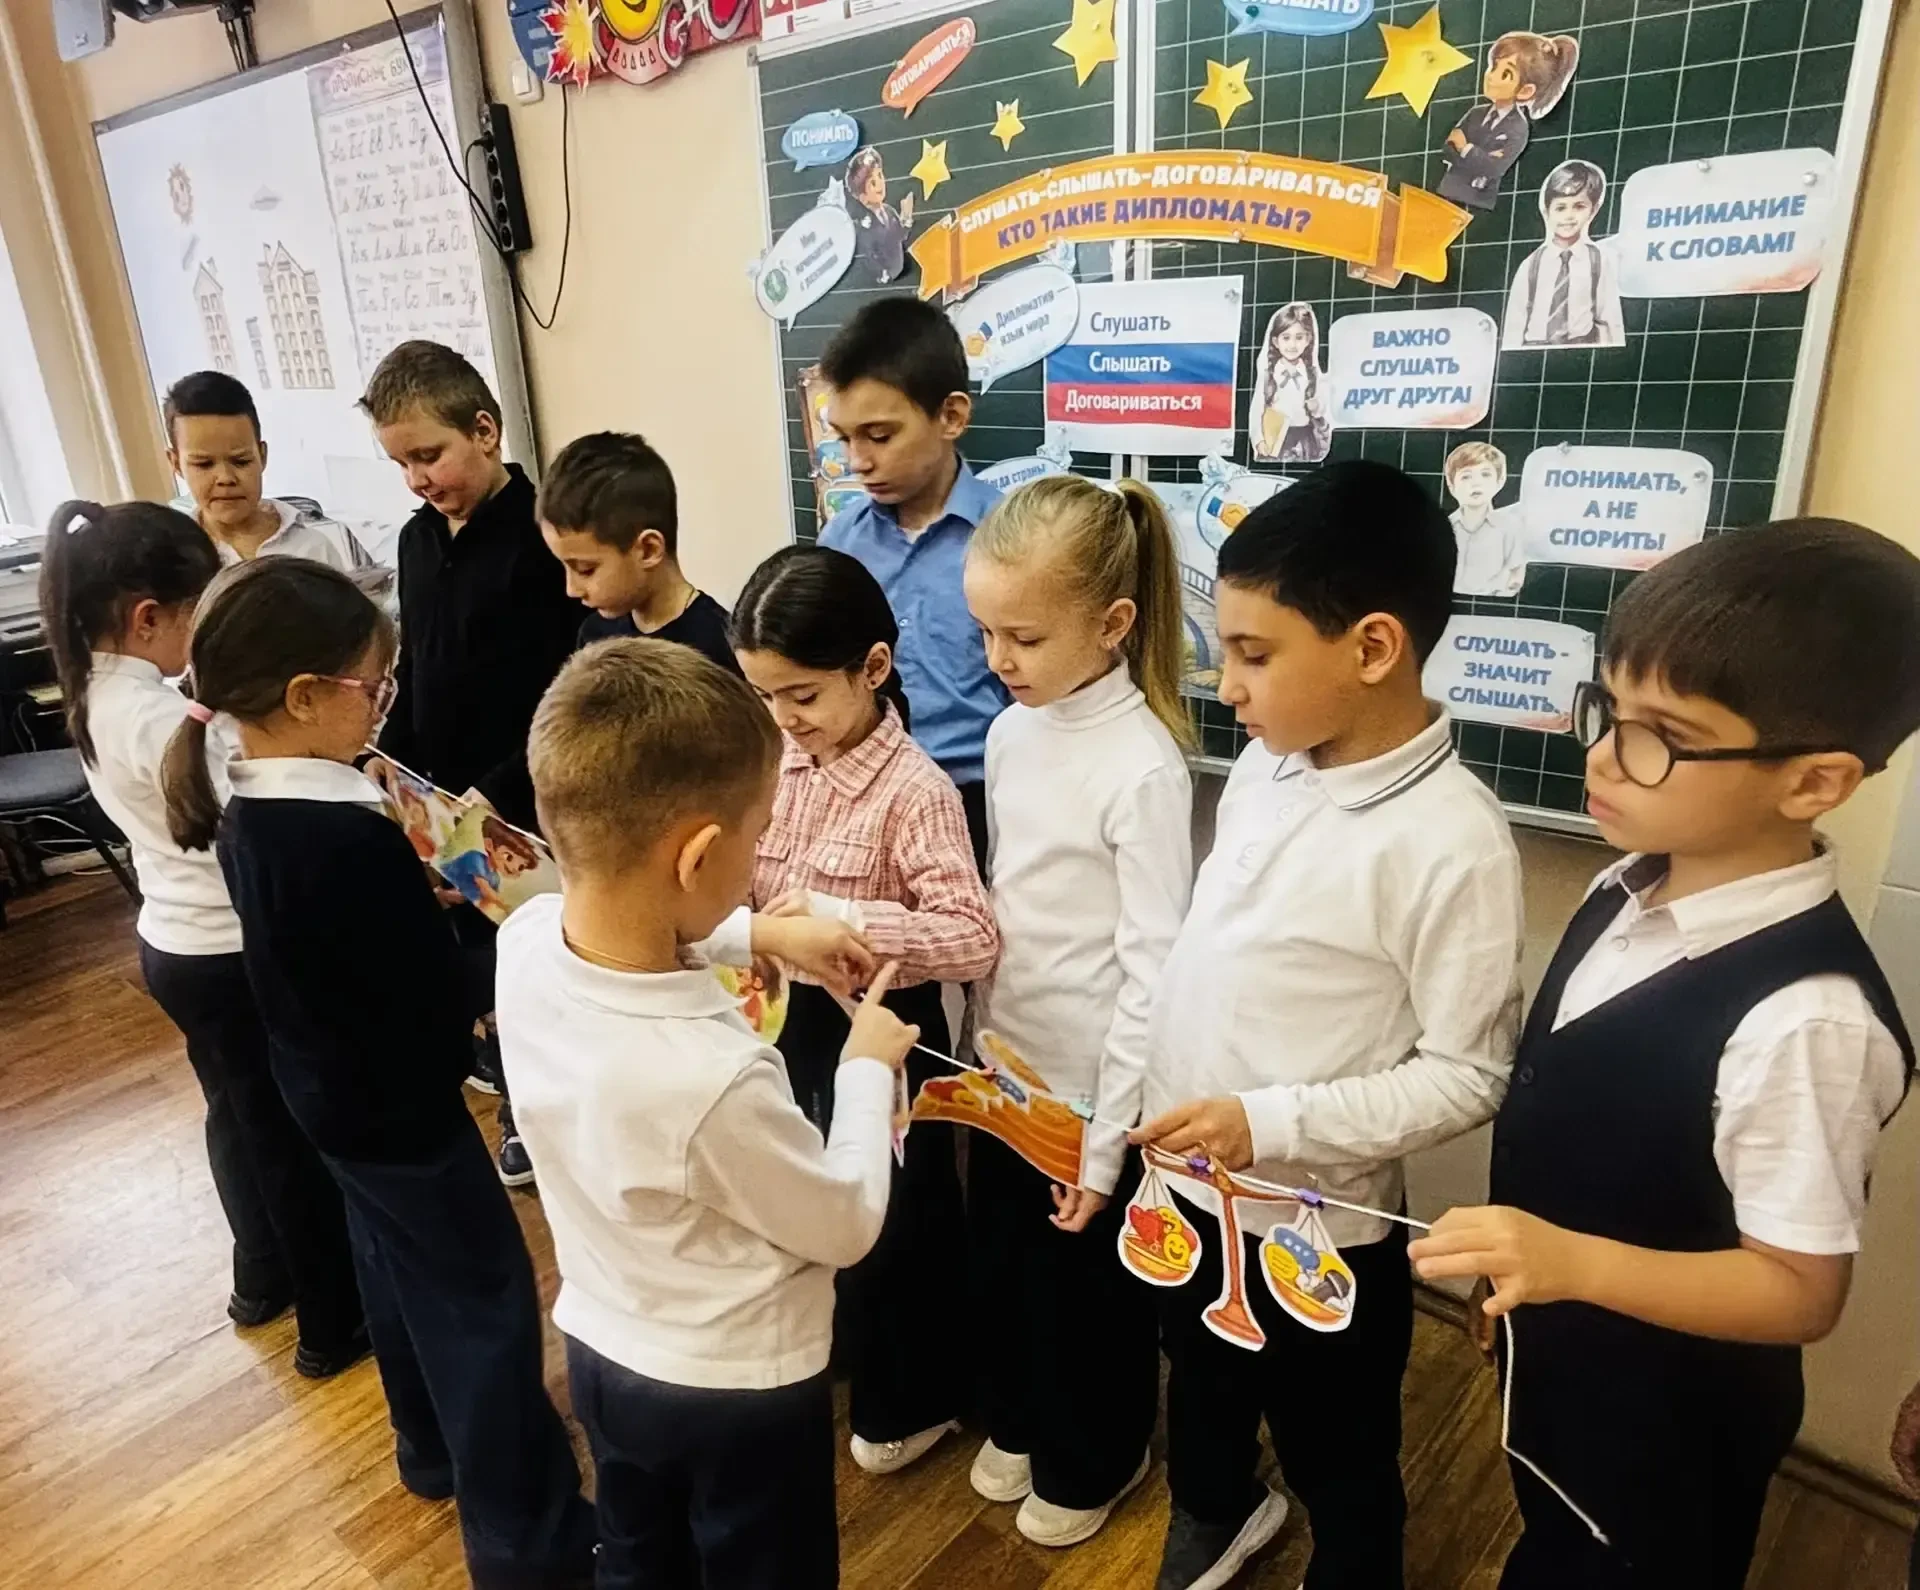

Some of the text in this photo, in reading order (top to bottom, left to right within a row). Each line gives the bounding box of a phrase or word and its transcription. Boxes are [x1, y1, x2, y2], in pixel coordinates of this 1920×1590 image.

[390, 51, 422, 78] БУКЫ
[890, 23, 971, 98] ДОГОВАРИВАТЬСЯ
[791, 124, 854, 148] ПОНИМАТЬ
[997, 197, 1312, 249] КТО ТАКИЕ ДИПЛОМАТЫ?
[1646, 194, 1807, 229] ВНИМАНИЕ
[1646, 231, 1796, 262] К СЛОВАМ!
[996, 289, 1054, 330] Дипломатия
[1025, 313, 1050, 333] мира
[1090, 312, 1171, 338] Слушать
[1372, 327, 1451, 349] ВАЖНО
[1089, 351, 1171, 374] Слышать
[1360, 357, 1460, 377] СЛУШАТЬ
[1065, 389, 1202, 415] Договариваться
[1343, 385, 1472, 409] ДРУГ ДРУГА!
[1544, 469, 1688, 494] ПОНИМАТЬ,
[1583, 500, 1638, 519] А НЕ
[1549, 527, 1666, 551] СПОРИТЬ!
[1453, 635, 1556, 659] СЛУШАТЬ
[1464, 661, 1552, 686] ЗНАЧИТ
[1448, 686, 1560, 714] СЛЫШАТЬ.
